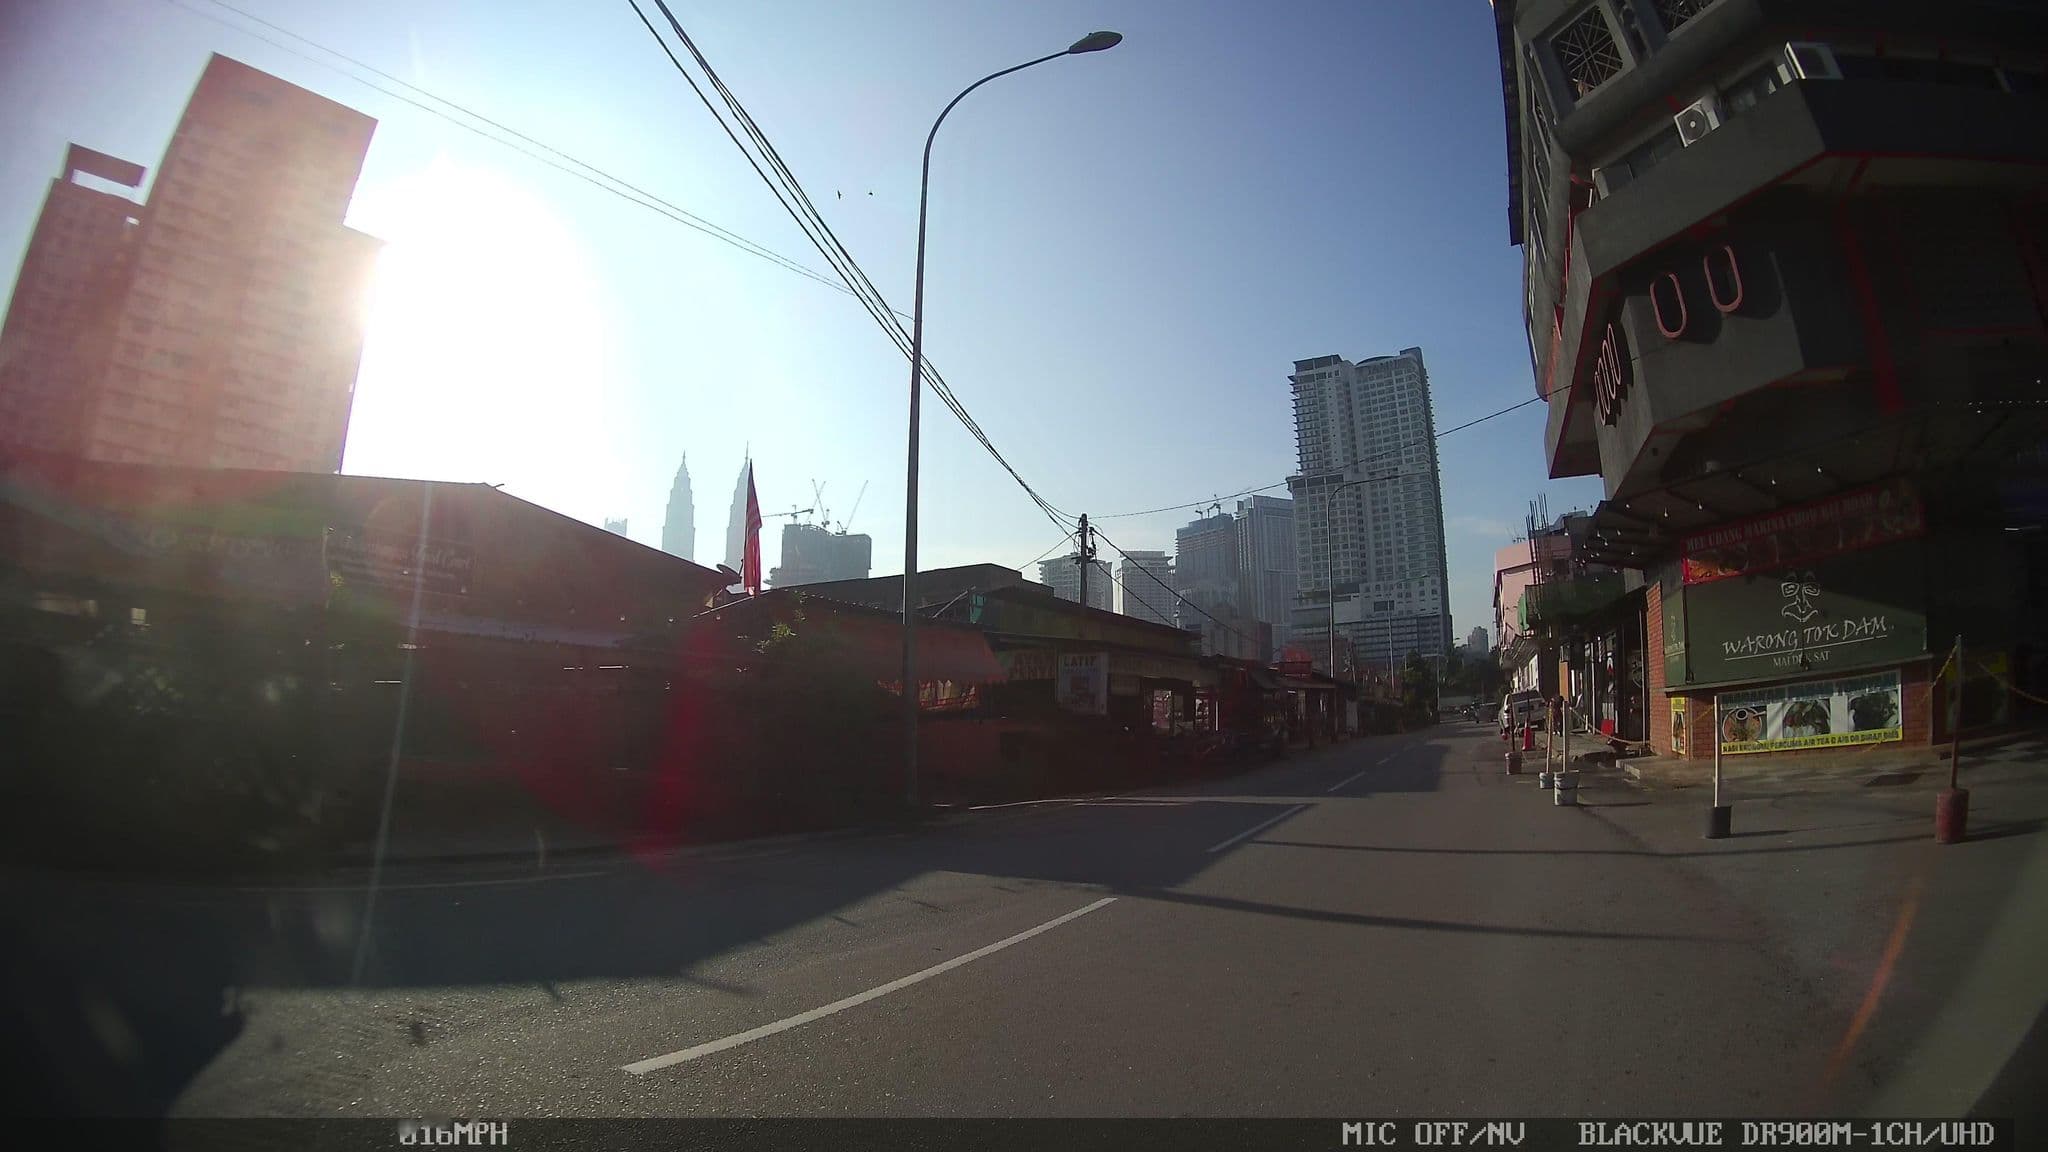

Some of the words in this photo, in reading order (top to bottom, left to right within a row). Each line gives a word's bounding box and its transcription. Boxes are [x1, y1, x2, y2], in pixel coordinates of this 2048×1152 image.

[1722, 629, 1798, 655] WARONG
[1803, 623, 1839, 644] TOK
[1843, 616, 1888, 641] DAM
